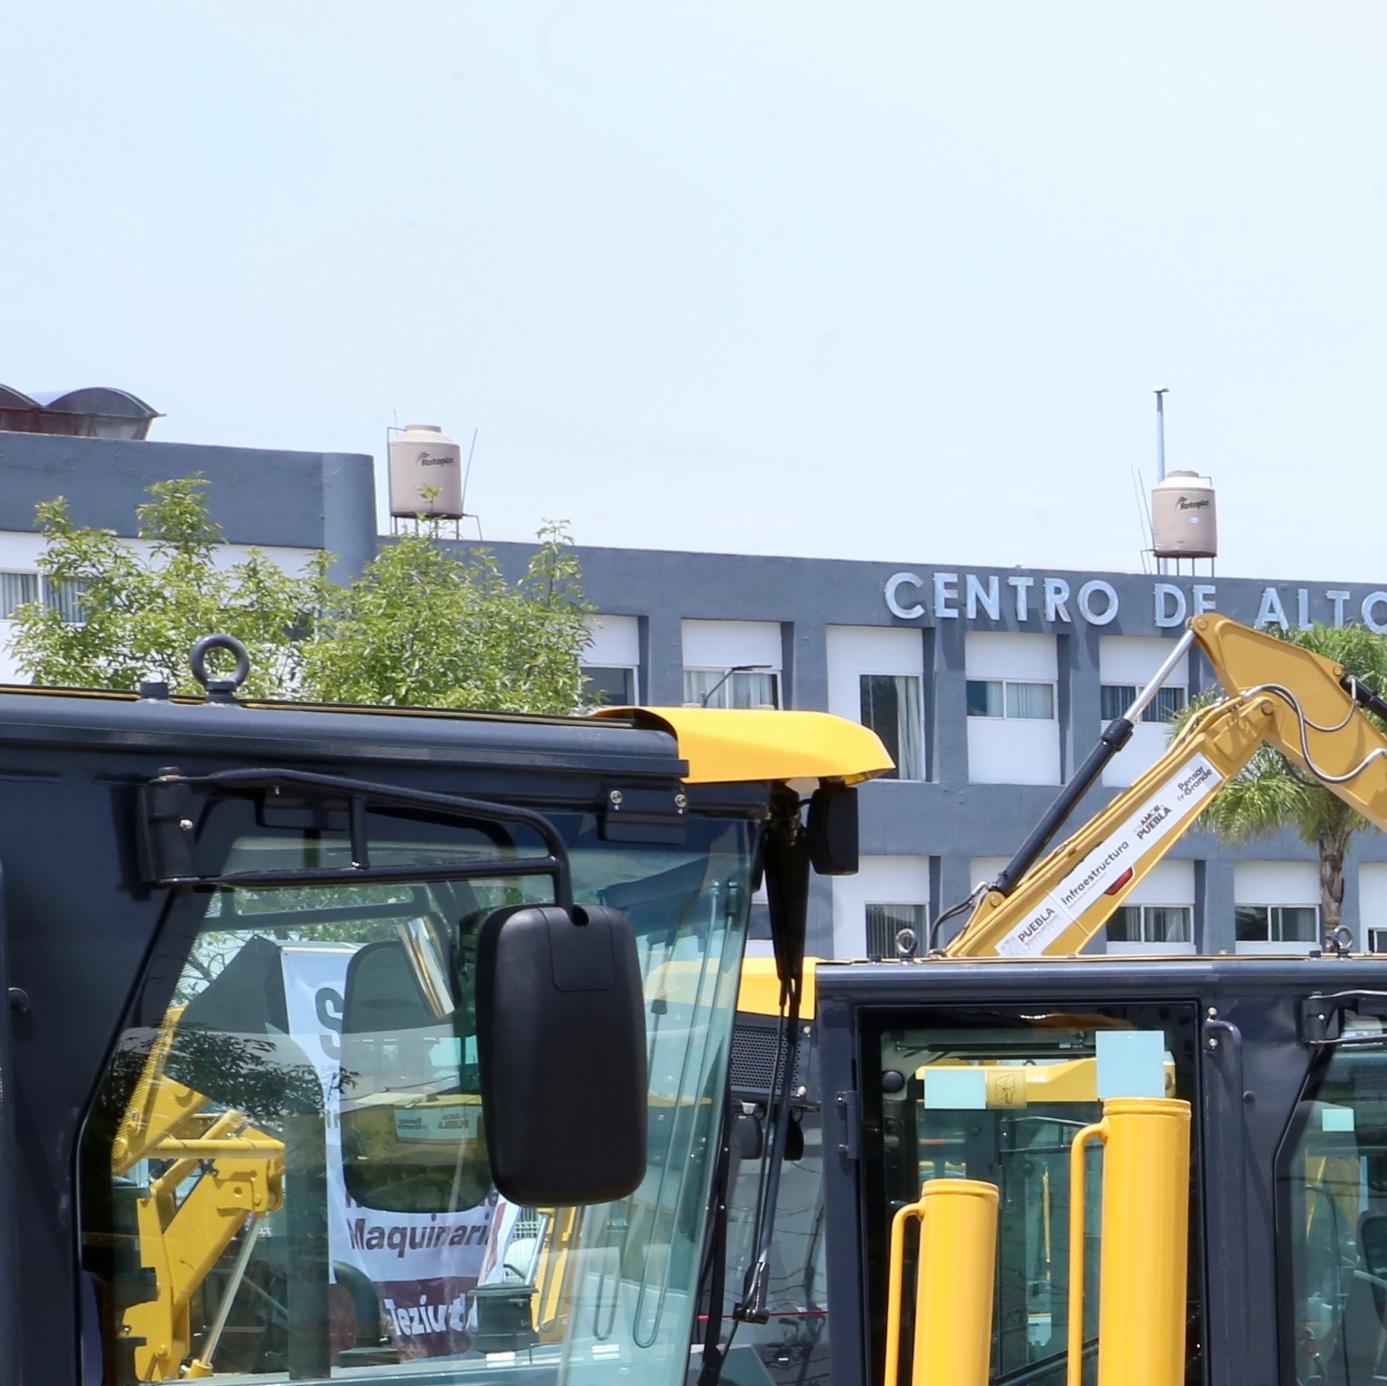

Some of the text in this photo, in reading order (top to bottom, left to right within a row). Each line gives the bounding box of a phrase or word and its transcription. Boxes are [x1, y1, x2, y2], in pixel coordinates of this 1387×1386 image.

[884, 572, 1119, 625] CENTRO
[1154, 583, 1217, 628] DE
[1177, 766, 1204, 791] Pensar
[1136, 806, 1172, 840] PUEBLA
[1061, 841, 1130, 905] Infraestructura
[1017, 908, 1056, 942] PUEBLA
[347, 1212, 492, 1259] Maquinari
